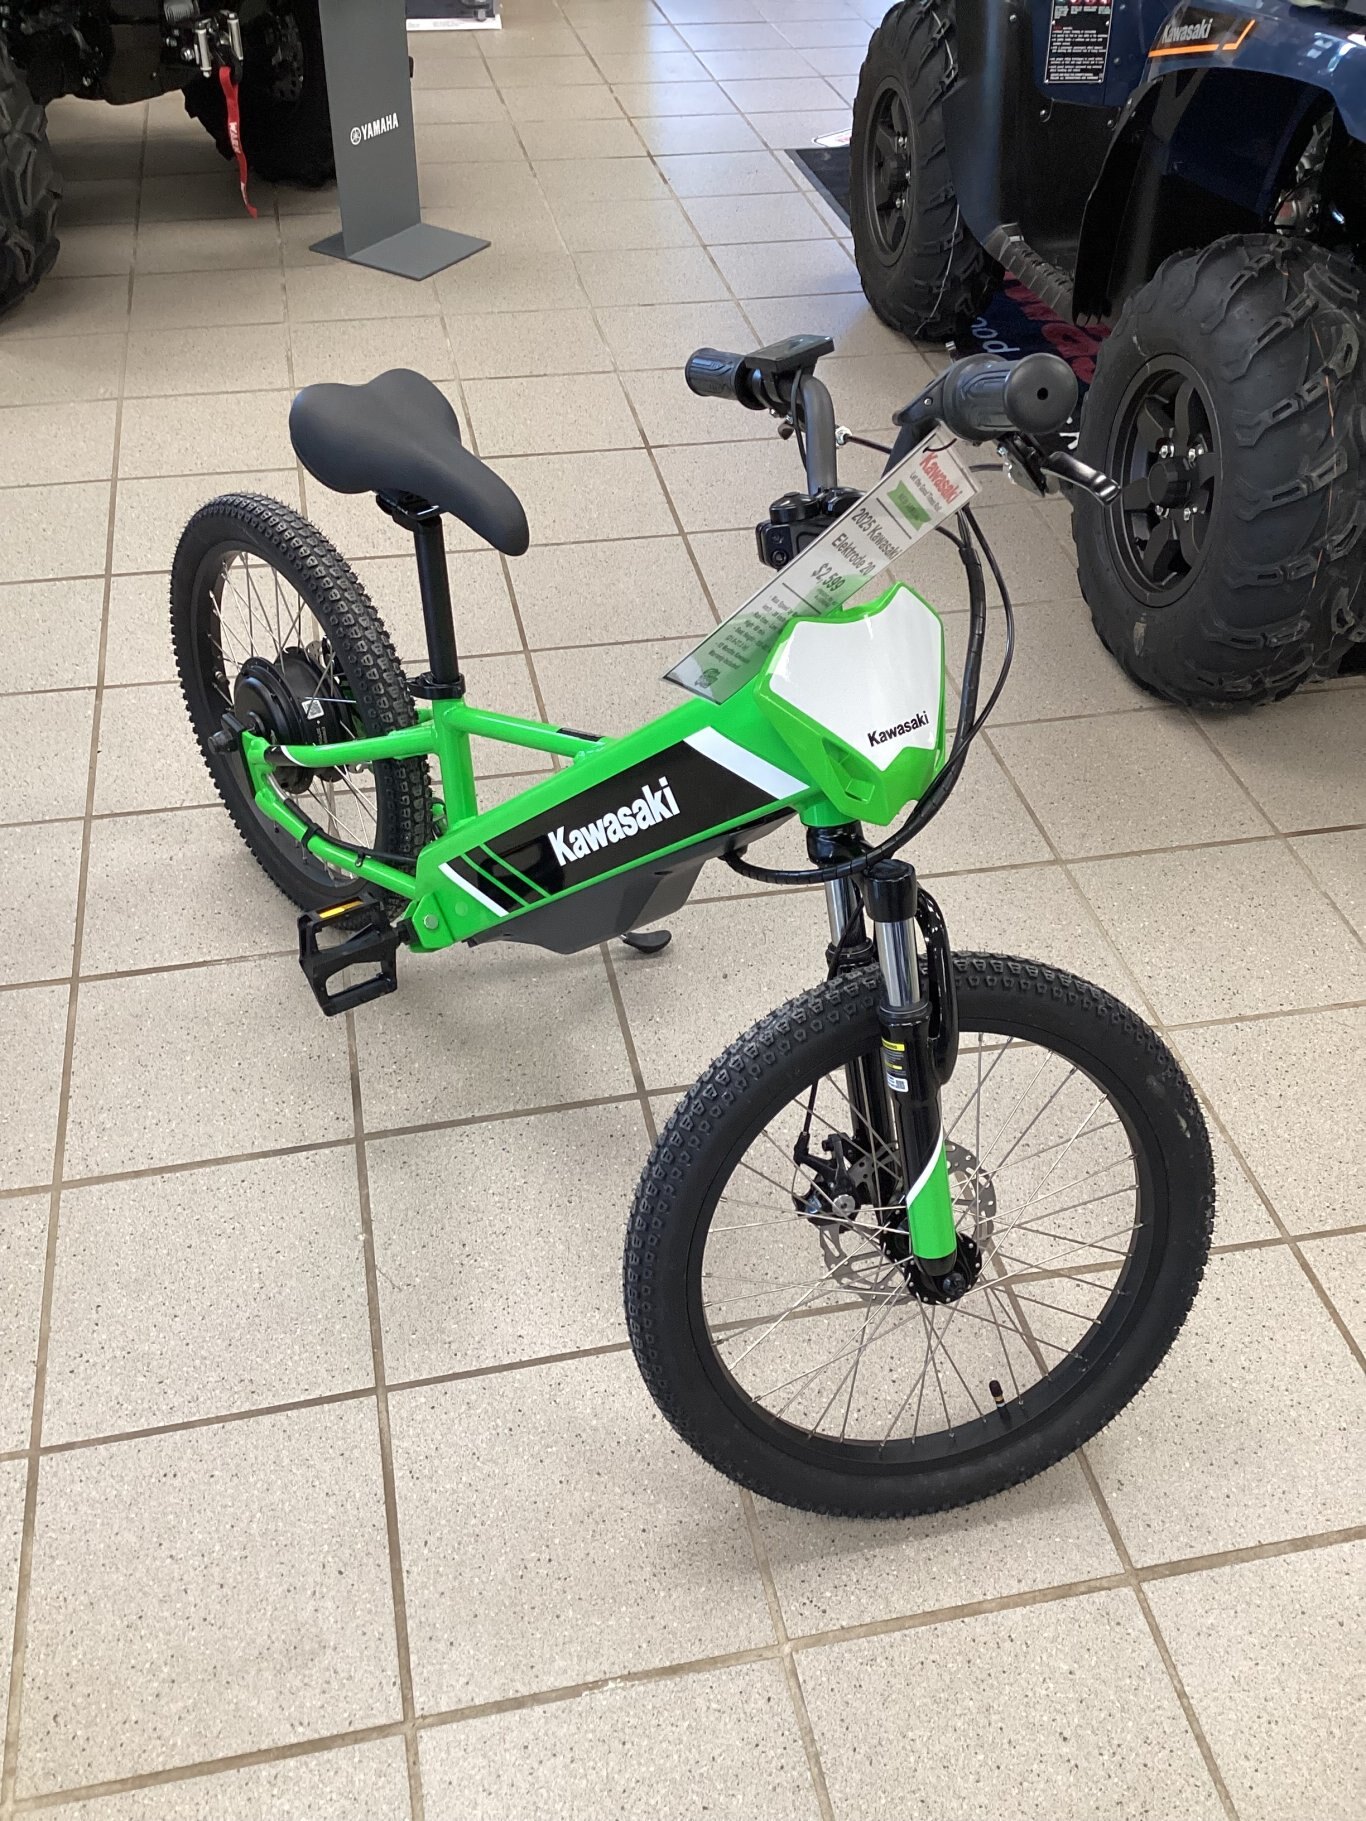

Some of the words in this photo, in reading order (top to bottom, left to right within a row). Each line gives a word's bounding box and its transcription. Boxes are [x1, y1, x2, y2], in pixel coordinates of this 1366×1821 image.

[1161, 18, 1214, 43] Kawasaki
[361, 112, 399, 141] YAMAHA
[920, 451, 961, 503] Kawasaki
[851, 507, 876, 531] 2025
[867, 524, 901, 559] Kawasaki
[831, 533, 865, 568] Elektrode
[858, 561, 875, 576] 20
[810, 562, 845, 591] $2,599
[867, 710, 929, 747] Kawasaki
[547, 776, 680, 867] Kawasaki
